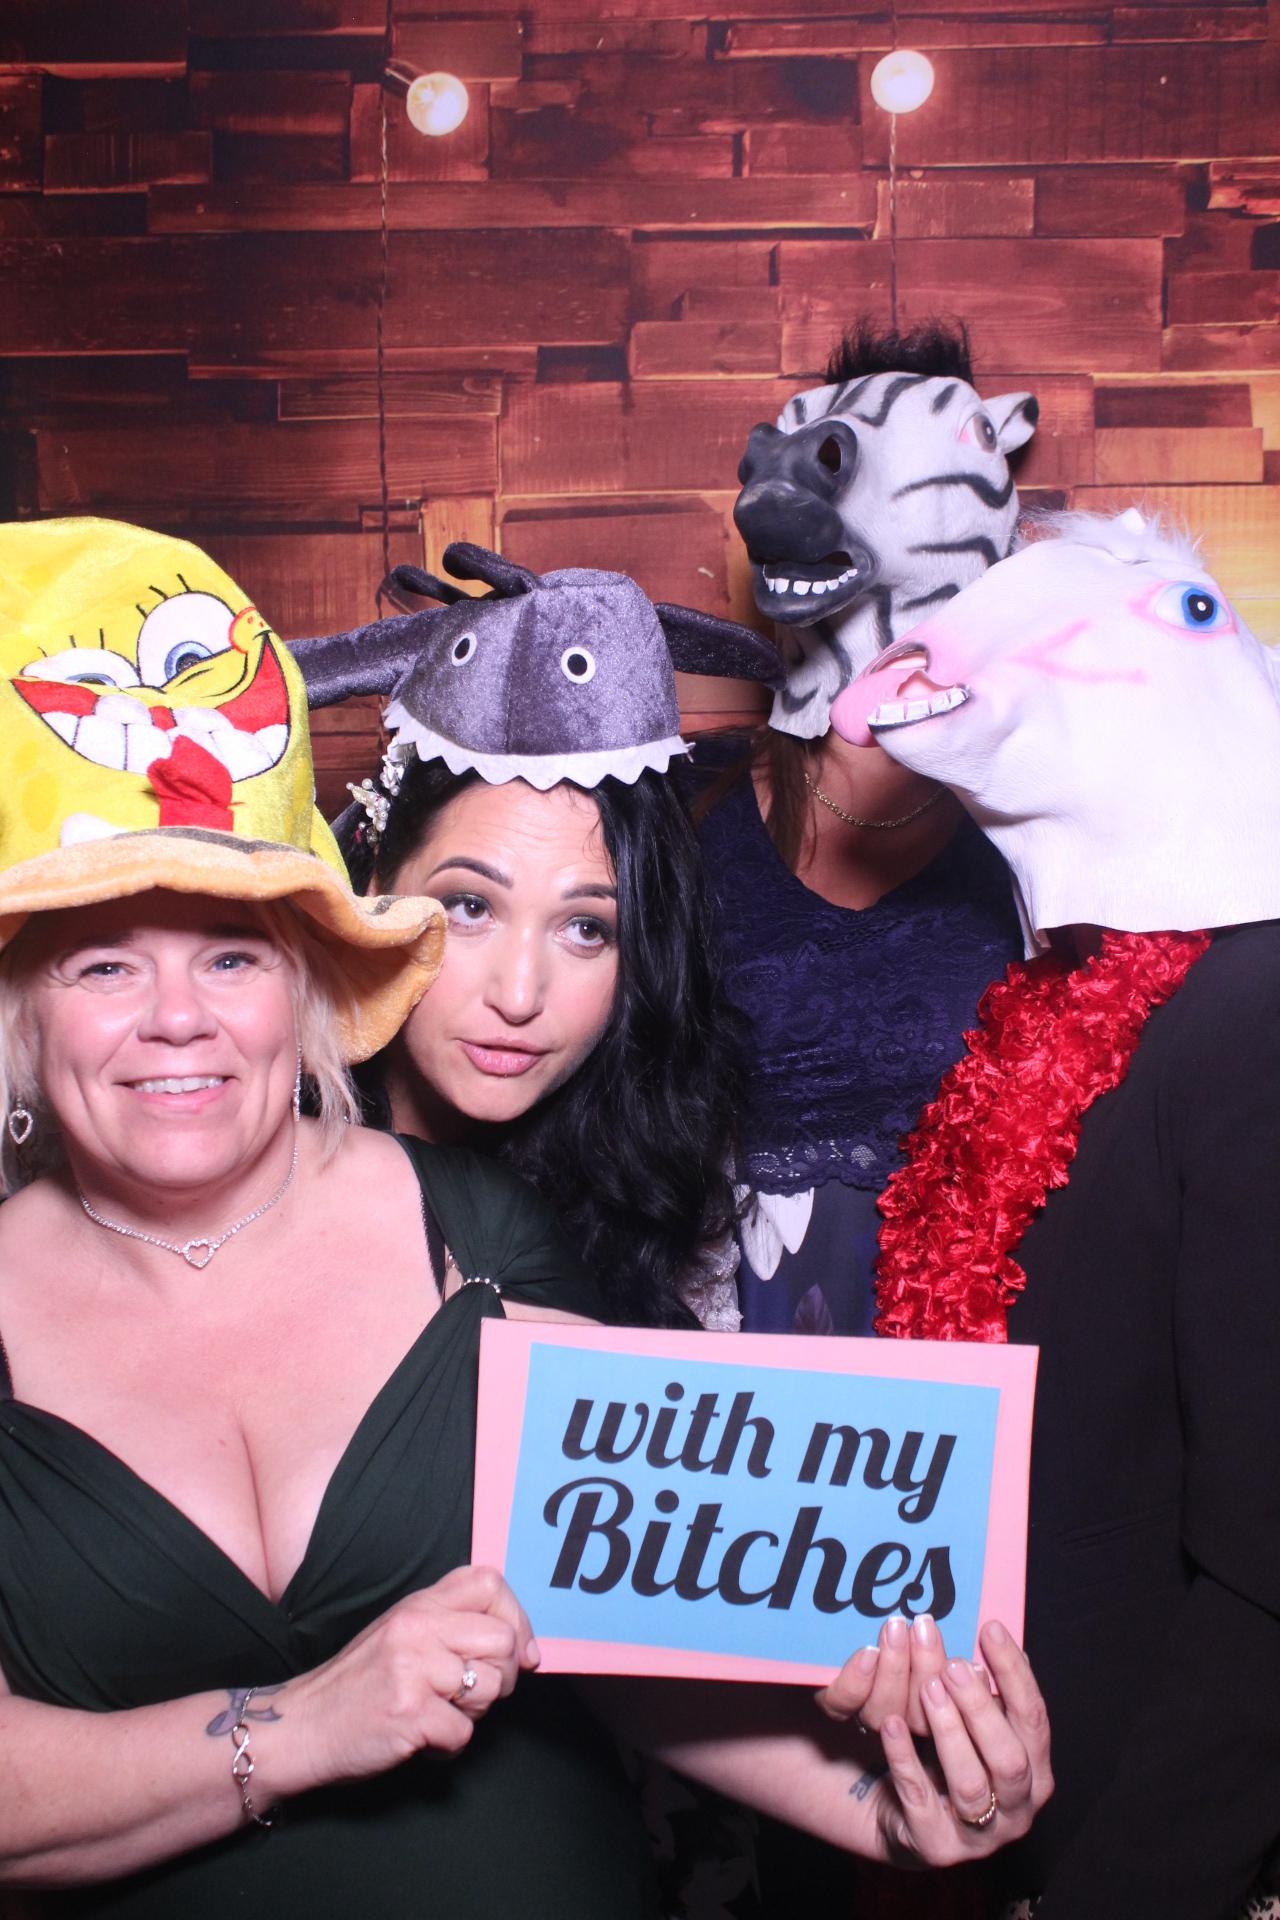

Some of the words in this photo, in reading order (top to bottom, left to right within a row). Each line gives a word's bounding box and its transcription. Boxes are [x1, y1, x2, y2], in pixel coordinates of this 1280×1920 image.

[562, 1382, 775, 1478] with
[798, 1422, 957, 1524] my
[543, 1477, 956, 1622] Bitches
